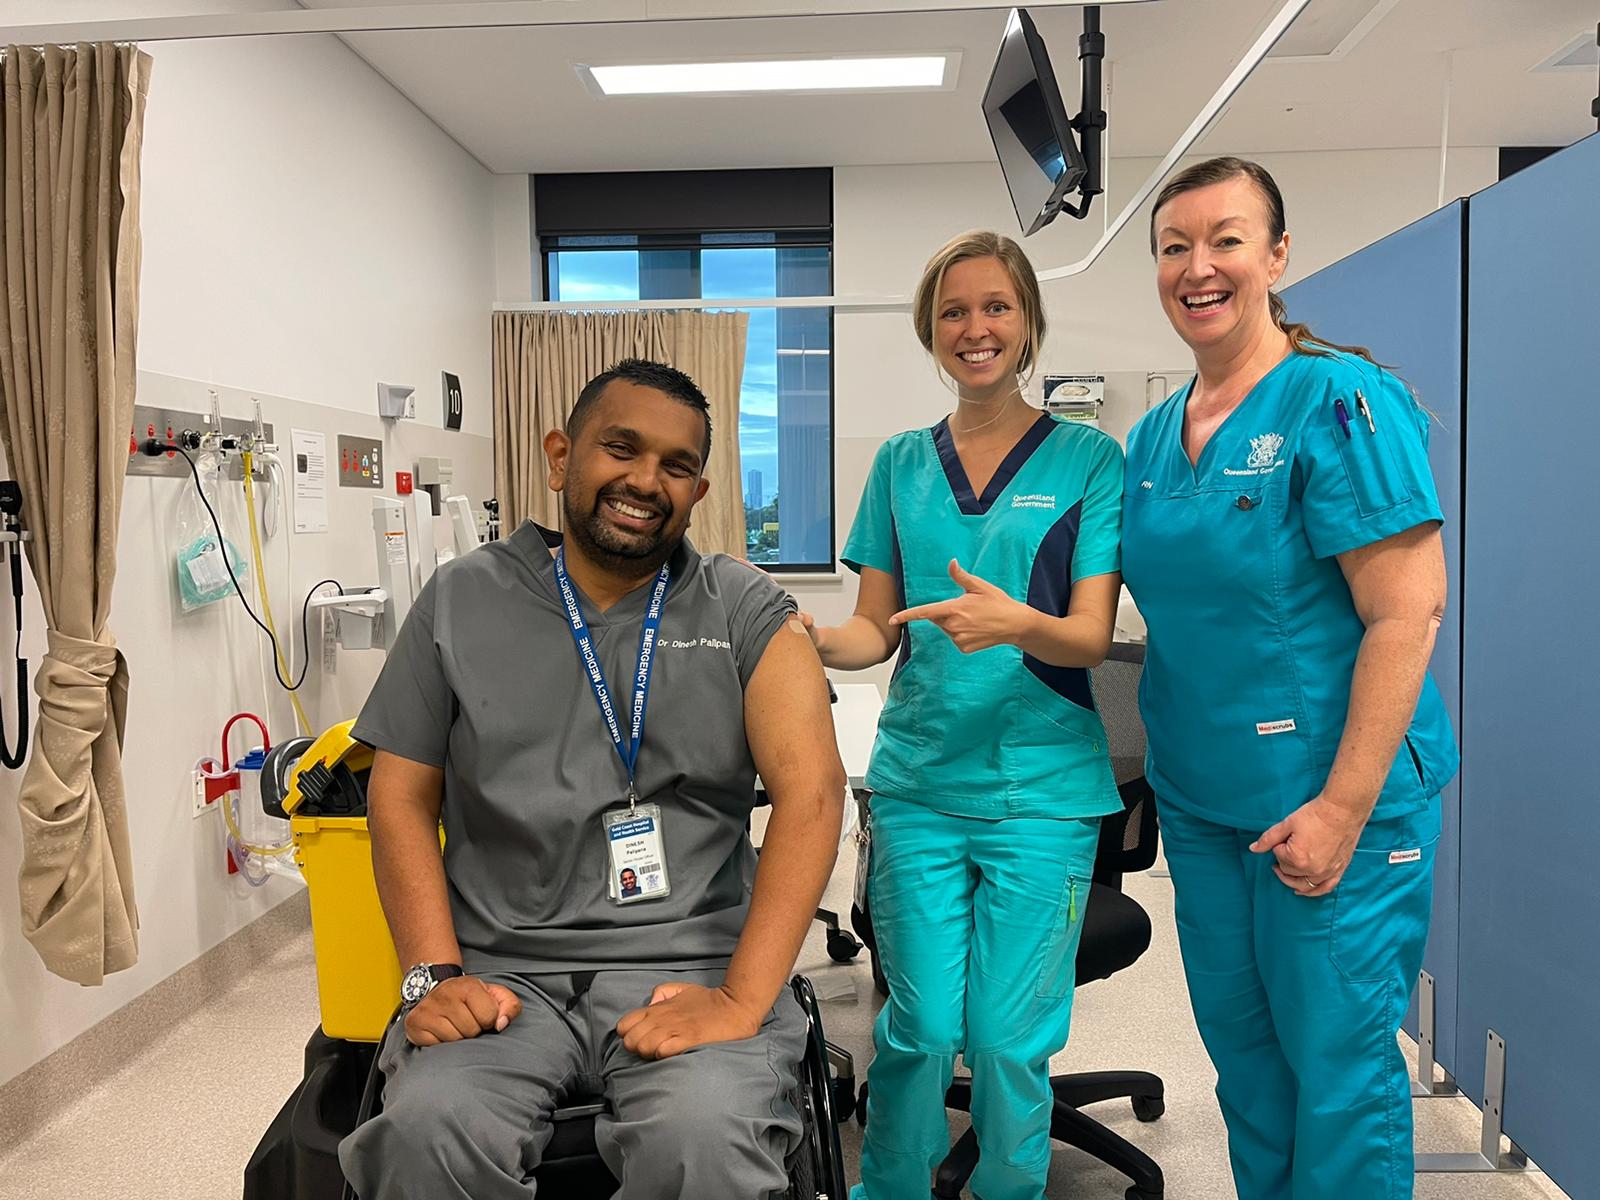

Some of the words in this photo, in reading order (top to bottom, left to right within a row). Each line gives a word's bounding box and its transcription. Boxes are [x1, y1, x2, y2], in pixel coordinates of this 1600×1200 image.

[449, 389, 460, 415] 10
[1011, 501, 1056, 509] Government
[1012, 494, 1056, 502] Queensland
[559, 576, 583, 630] EMERGENCY
[648, 581, 666, 619] MEDICINE
[579, 637, 602, 682] MEDICINE
[637, 628, 655, 689] EMERGENCY
[657, 639, 669, 647] Dr
[672, 639, 697, 649] Dinesh
[595, 684, 621, 744] EMERGENCY
[631, 690, 645, 739] MEDICINE
